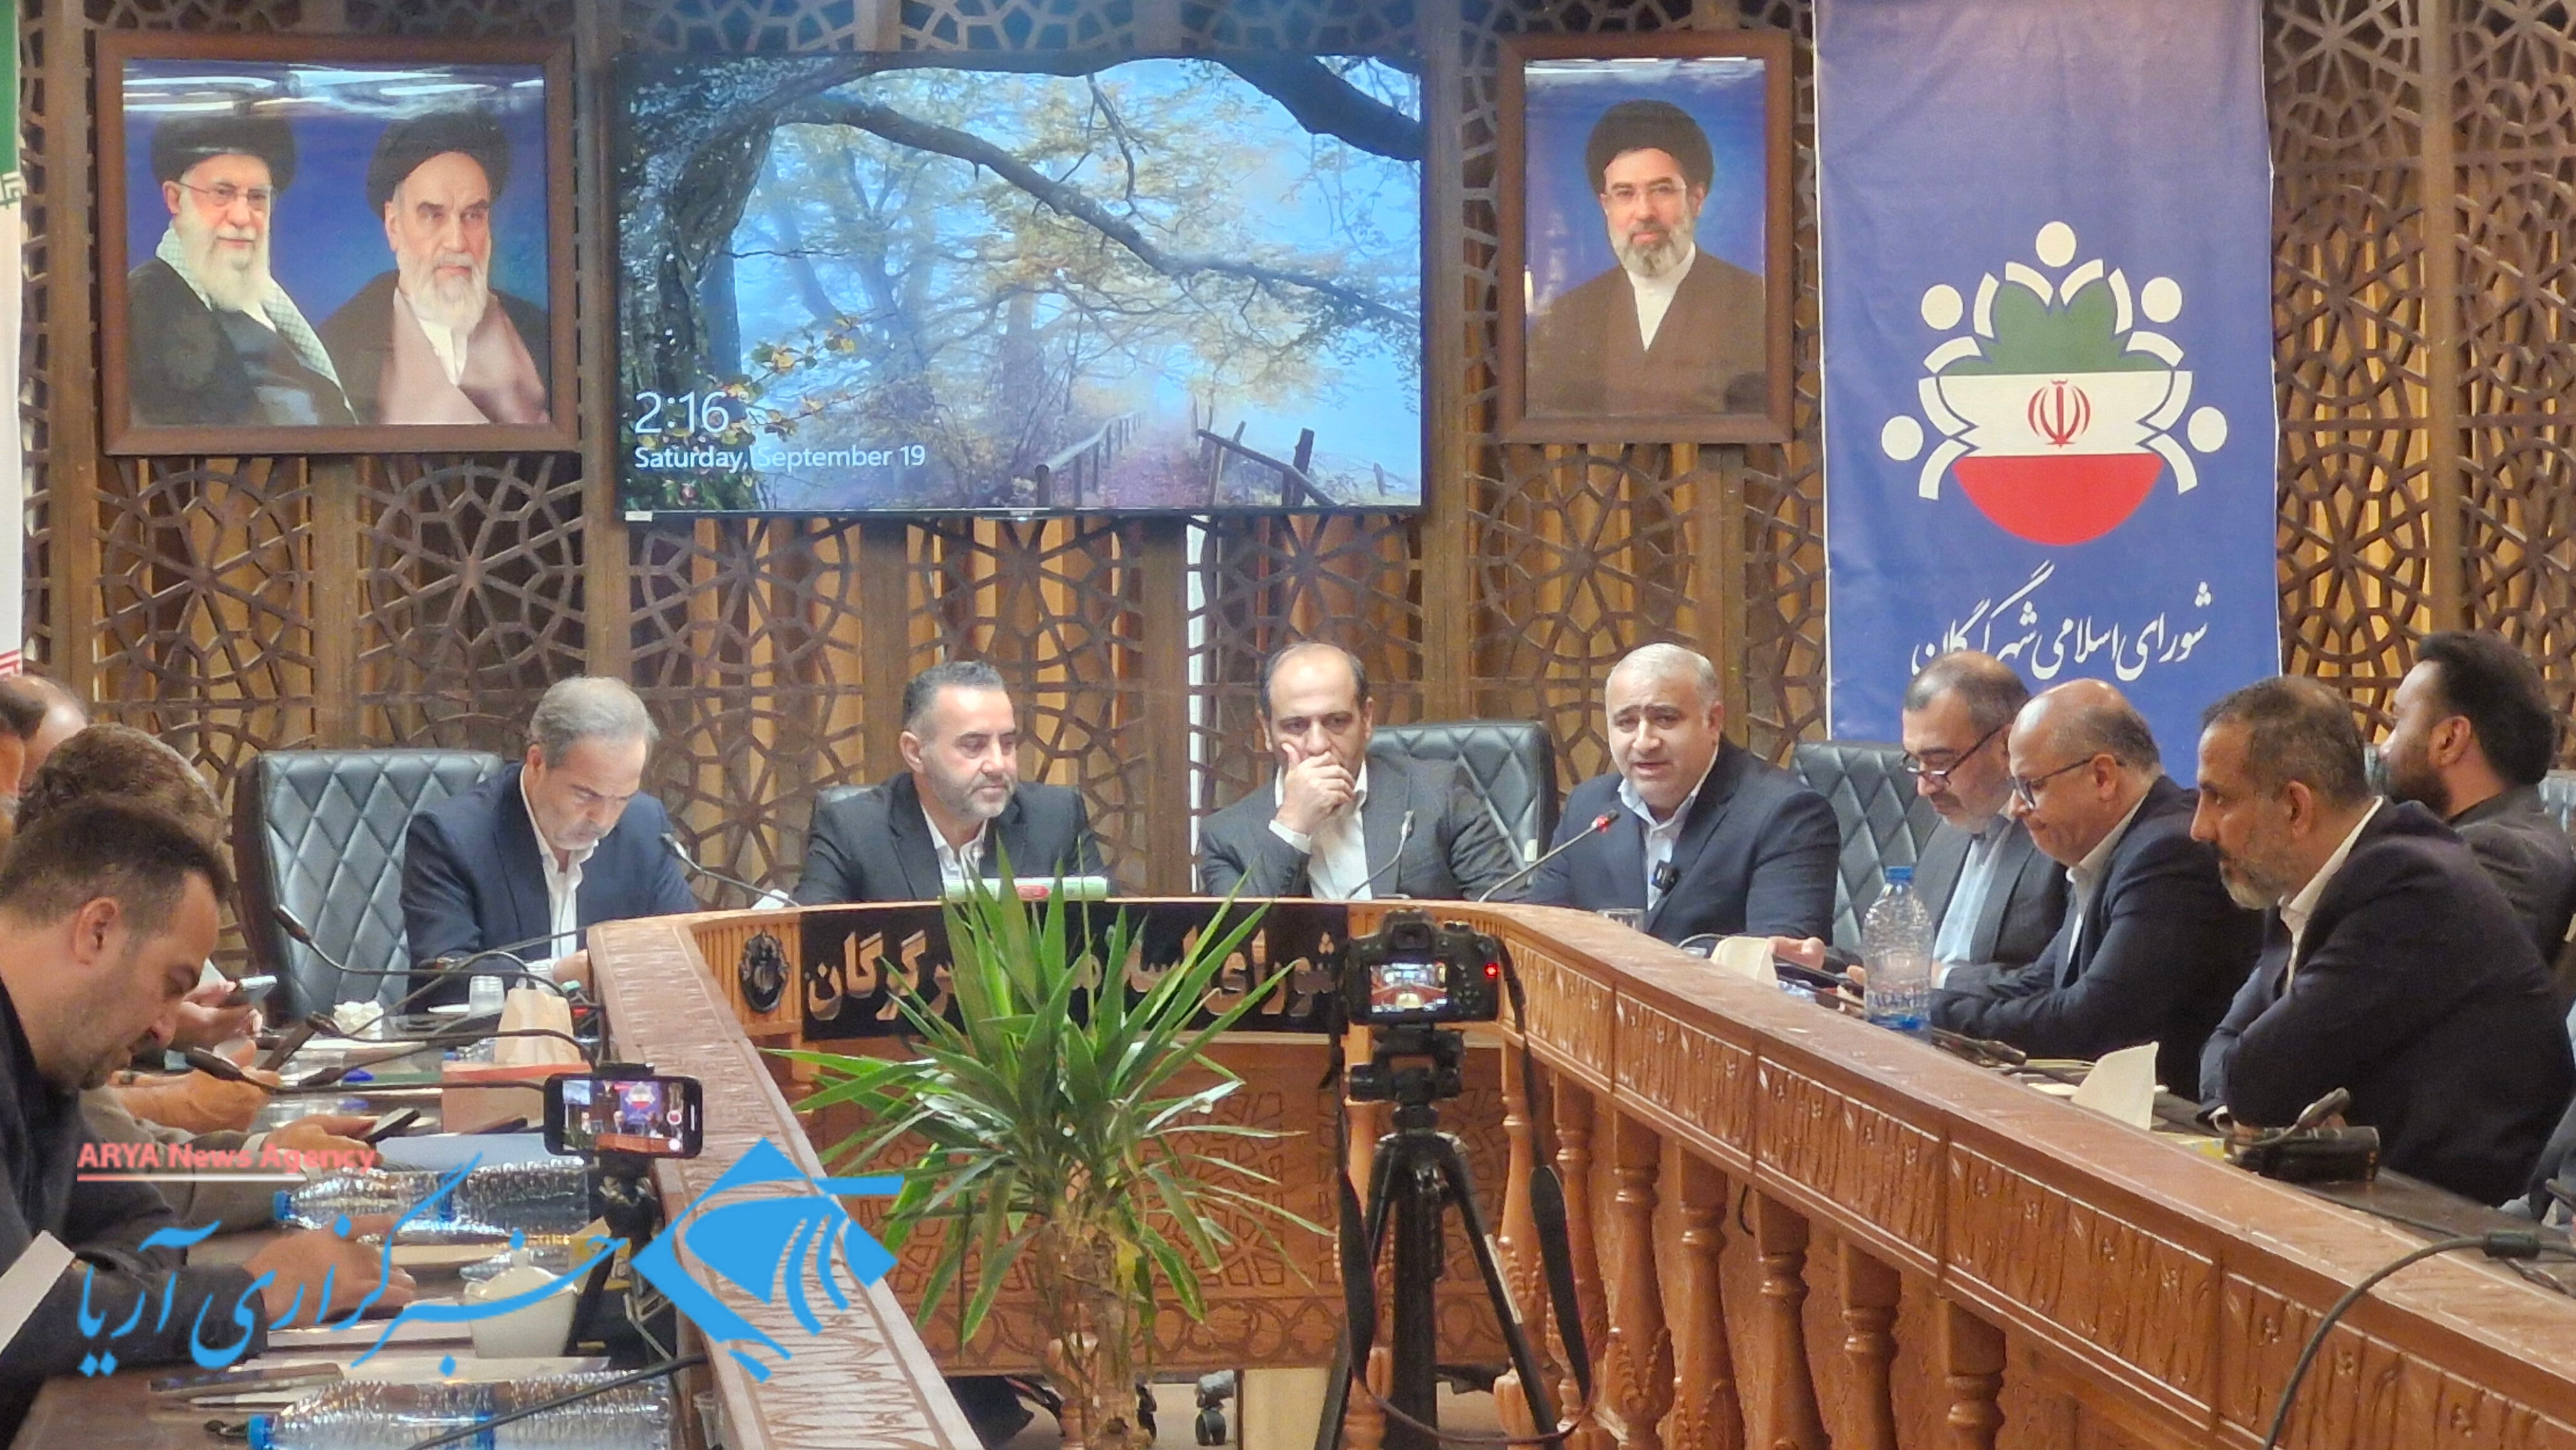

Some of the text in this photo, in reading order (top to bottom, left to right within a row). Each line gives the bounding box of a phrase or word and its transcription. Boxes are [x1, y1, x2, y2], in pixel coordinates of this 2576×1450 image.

[633, 390, 730, 434] 2:16
[634, 444, 926, 473] Saturday, September 19
[2031, 614, 2120, 680] اسلامی
[2115, 580, 2212, 682] شورای
